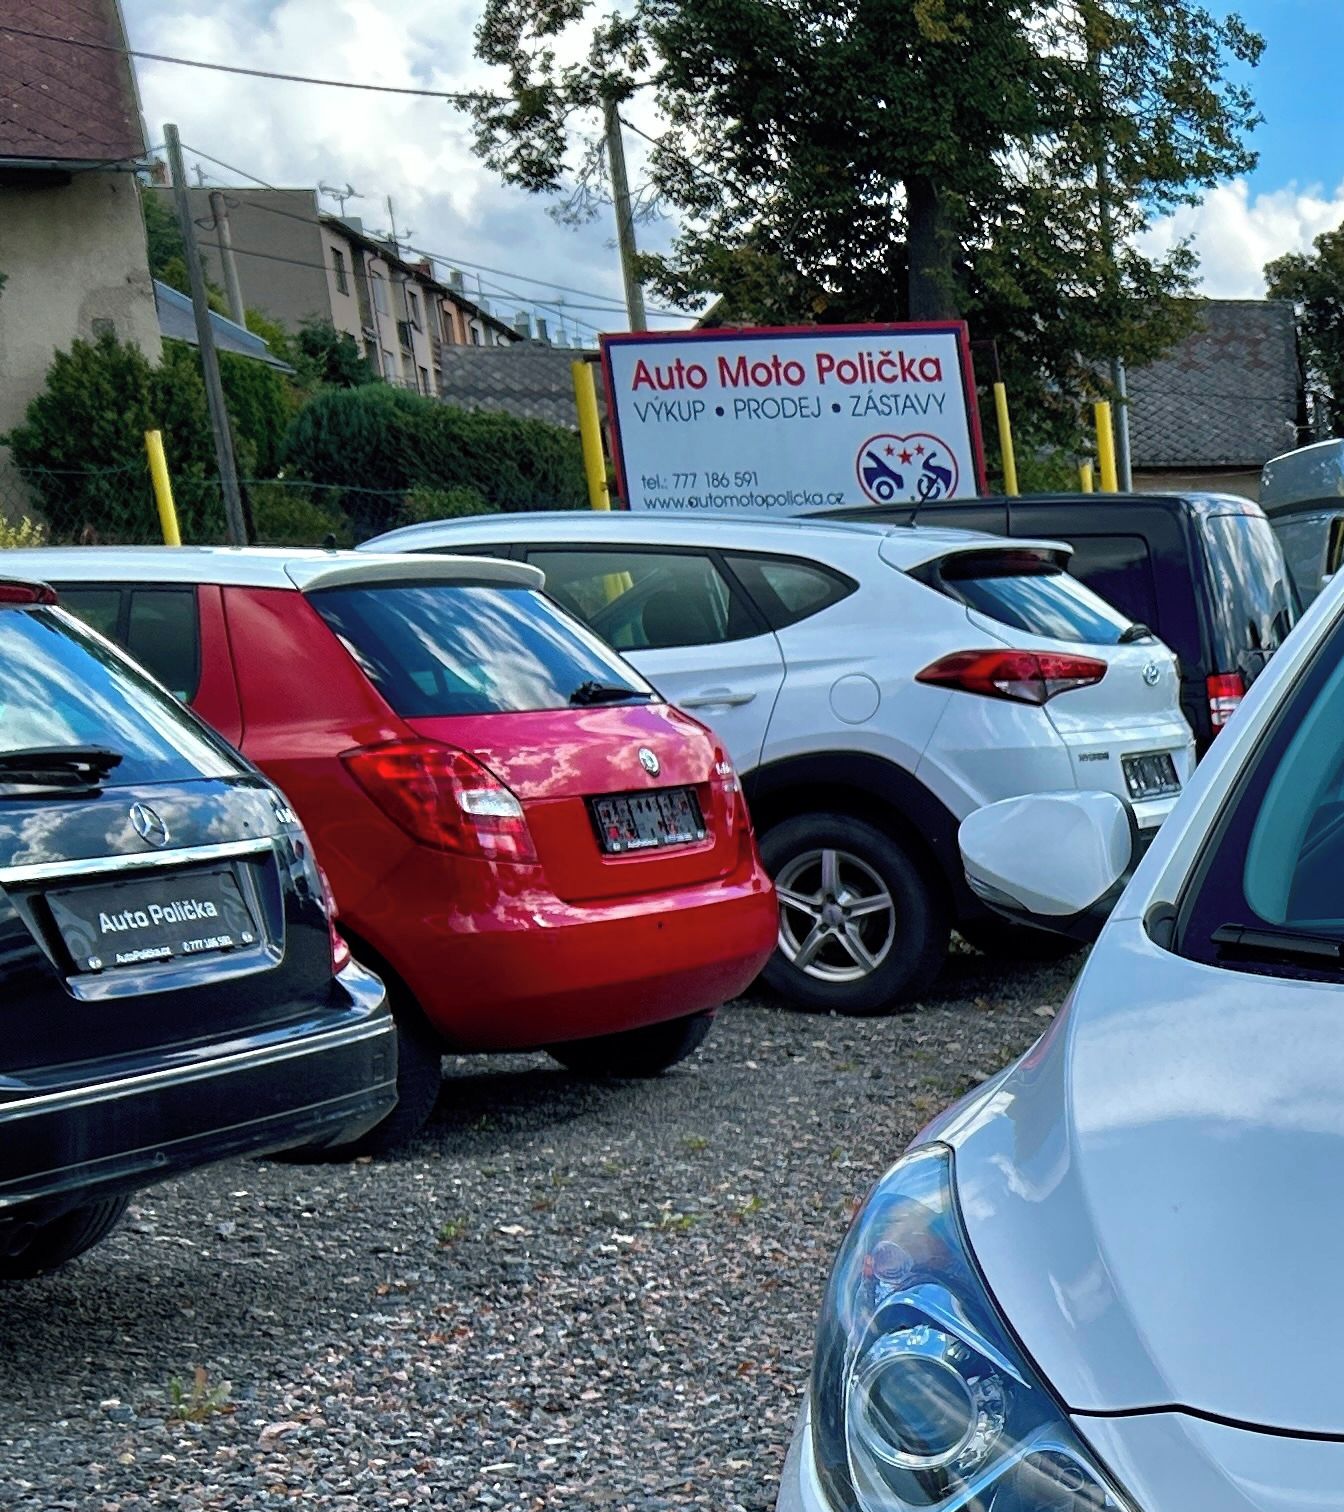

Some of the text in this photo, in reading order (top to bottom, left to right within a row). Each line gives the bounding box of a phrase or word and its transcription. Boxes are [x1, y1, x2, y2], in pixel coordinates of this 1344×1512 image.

[632, 350, 942, 391] Auto Moto Polička
[633, 389, 947, 424] VÝKUP PRODEJ ZÁSTAVY
[641, 471, 759, 491] tel.: 777 186 591
[643, 489, 846, 510] www.automotopolicka.cz
[99, 899, 218, 933] Auto Polička
